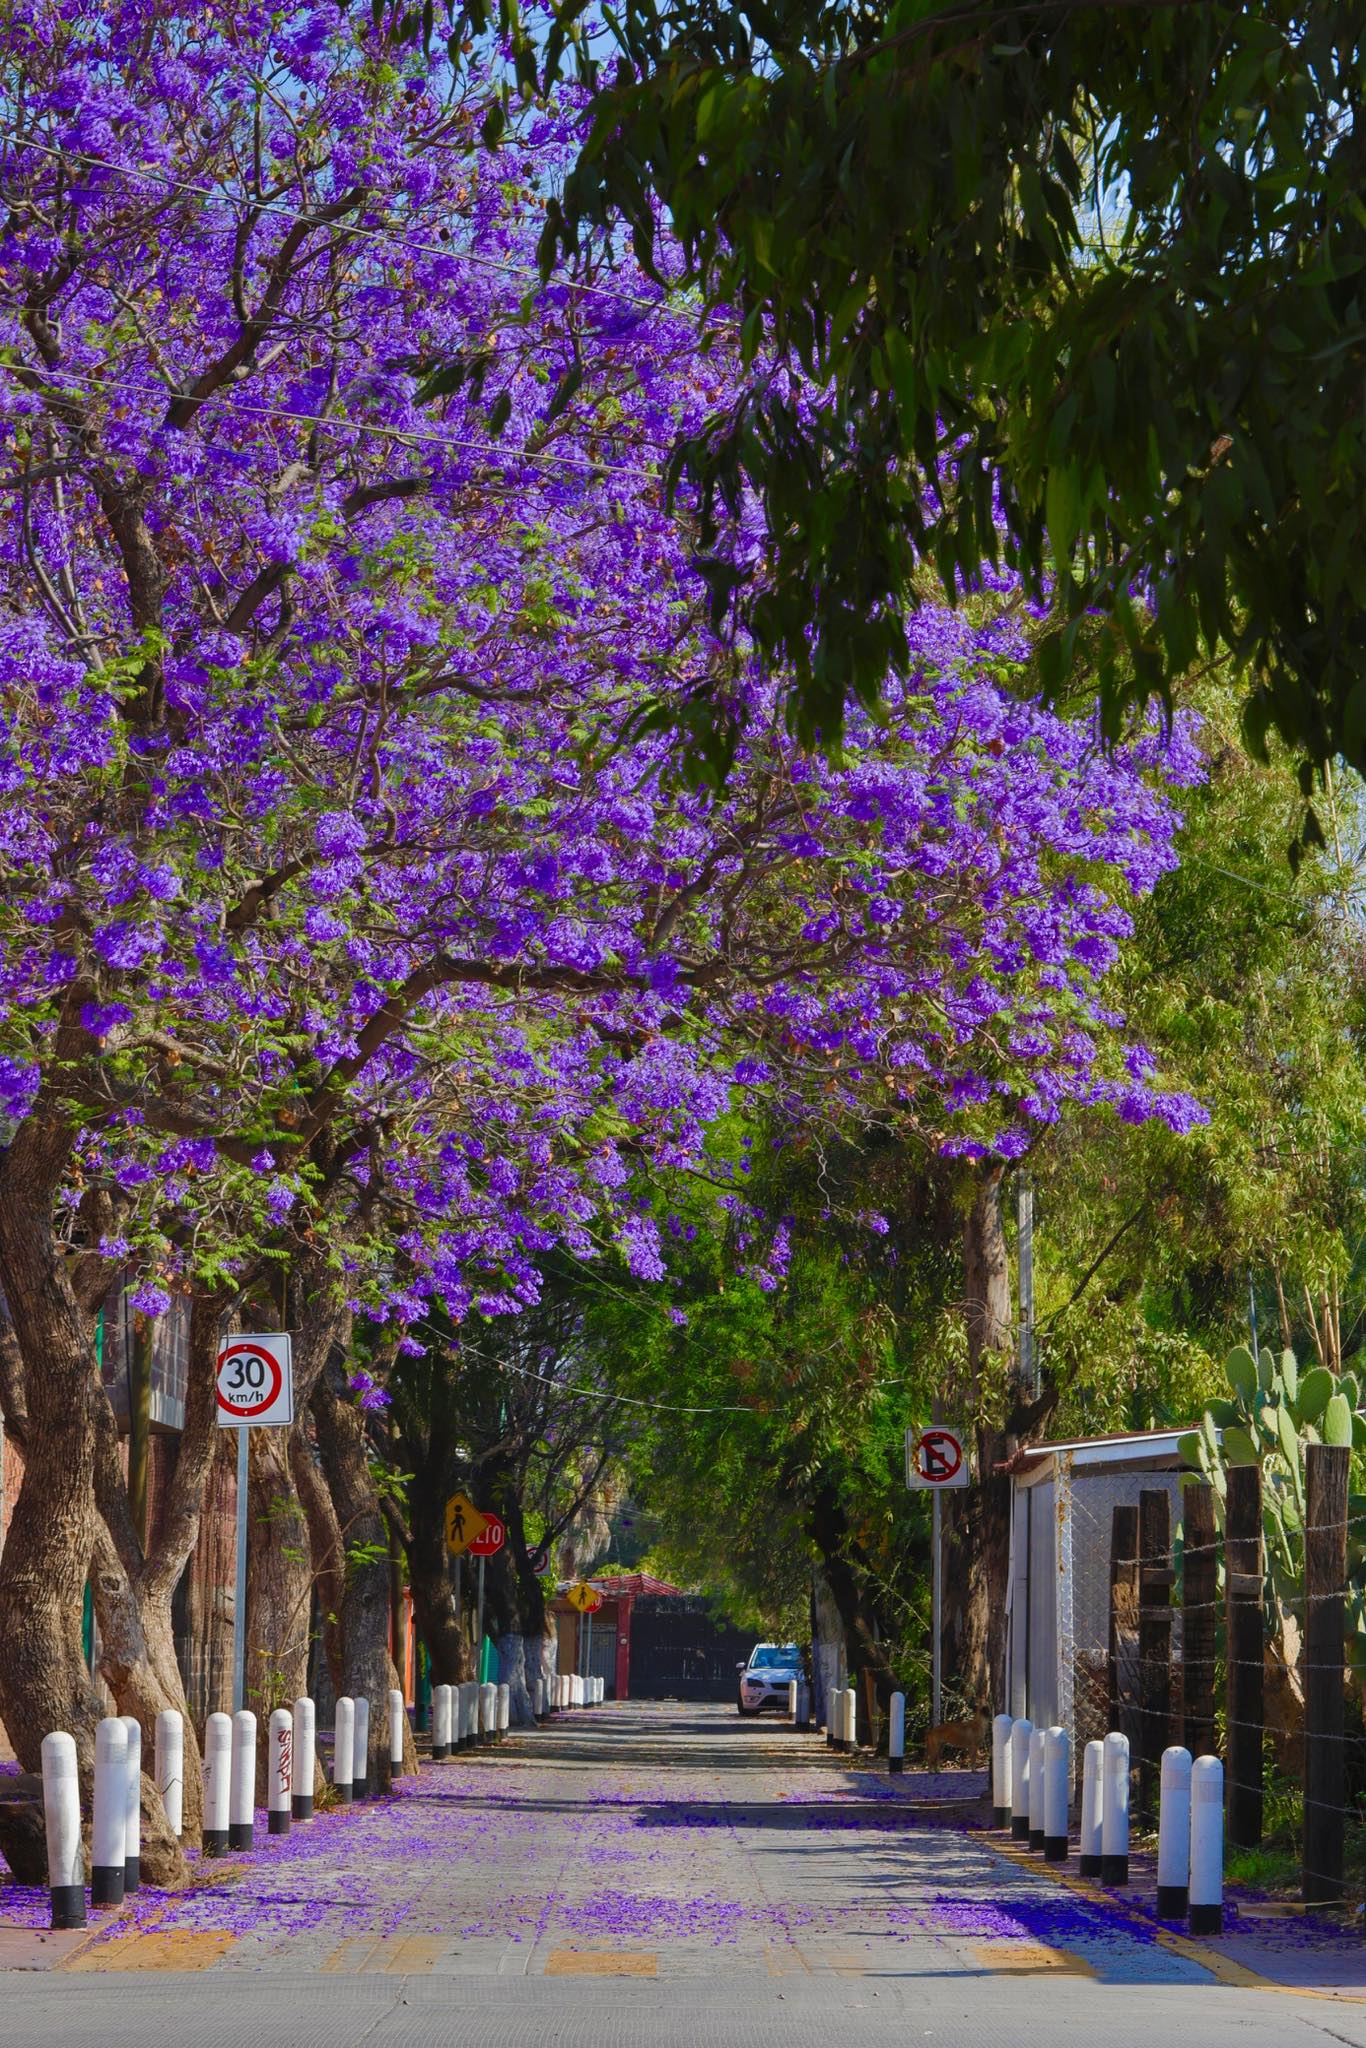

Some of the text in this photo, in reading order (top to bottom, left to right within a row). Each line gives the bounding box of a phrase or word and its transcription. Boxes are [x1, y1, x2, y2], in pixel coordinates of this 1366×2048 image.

[226, 1357, 265, 1389] 30
[228, 1390, 264, 1403] km/h
[473, 1525, 501, 1544] LTO
